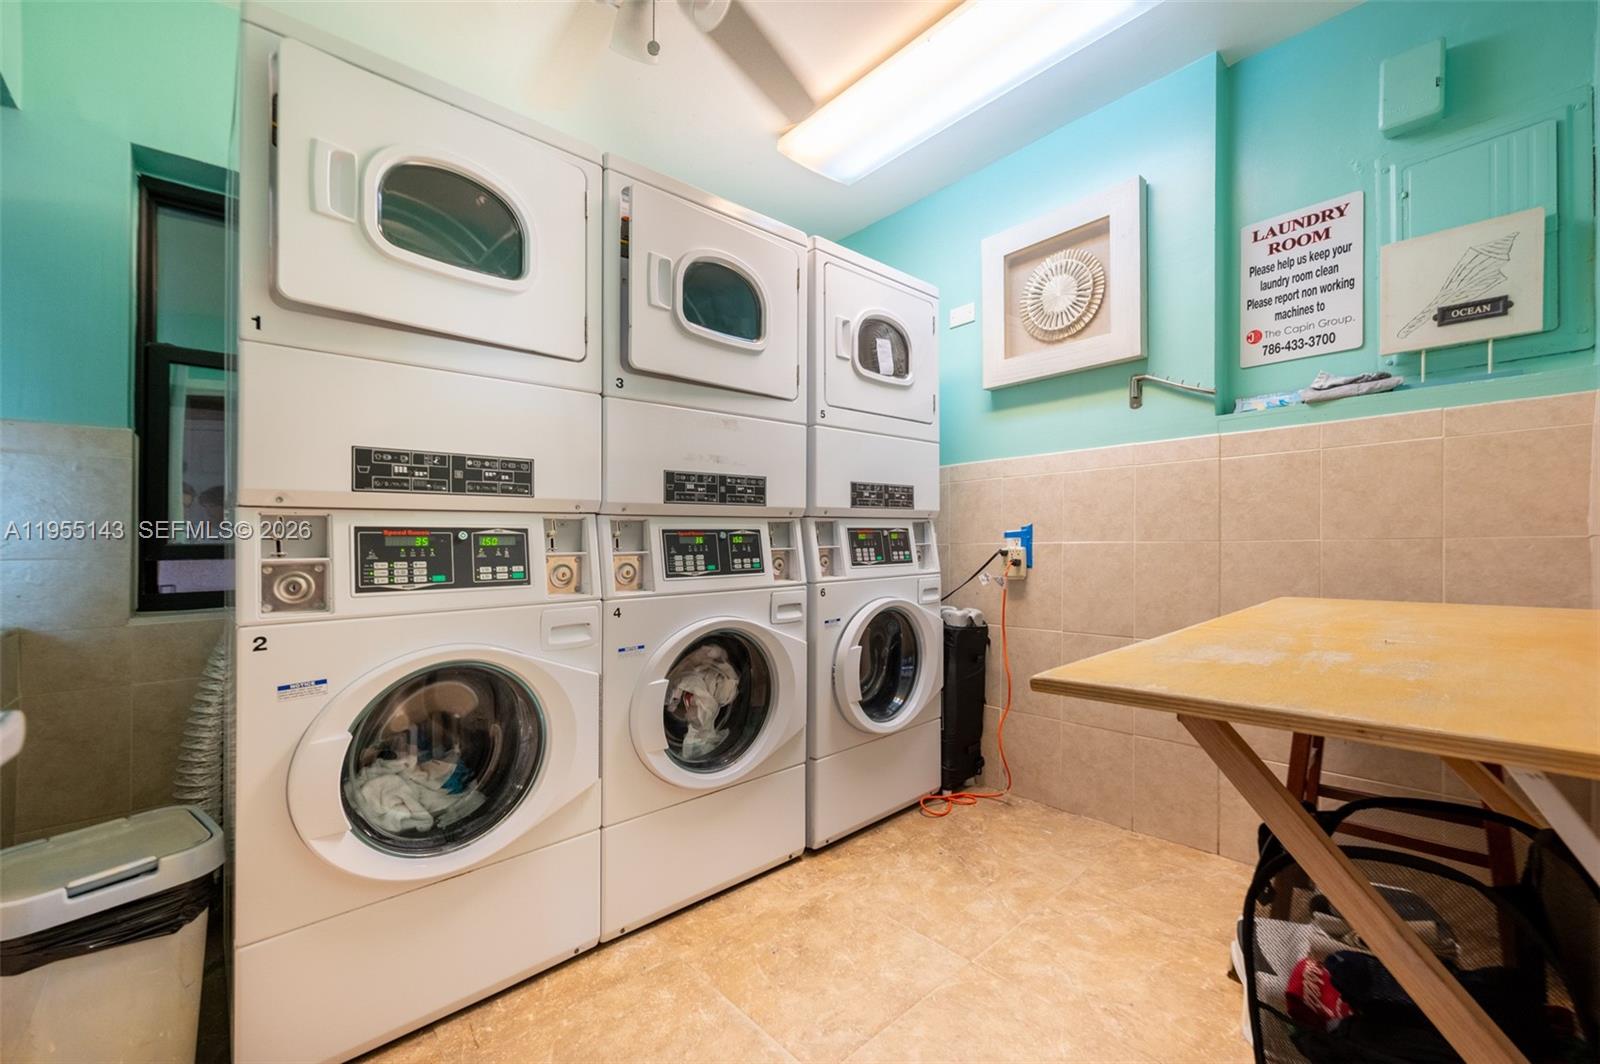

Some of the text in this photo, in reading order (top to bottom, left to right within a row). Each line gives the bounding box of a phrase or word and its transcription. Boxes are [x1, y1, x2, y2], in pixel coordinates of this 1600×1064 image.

[1252, 202, 1350, 243] LAUNDRY
[1267, 227, 1332, 256] ROOM
[1249, 242, 1353, 277] Please help us keep your
[1260, 264, 1339, 291] laundry room clean
[1247, 277, 1355, 310] Please report non working
[1274, 301, 1326, 321] machines to
[1451, 303, 1491, 318] OCEAN
[251, 316, 261, 329] 1
[1265, 330, 1282, 339] The
[1262, 332, 1336, 356] 786-433-3700
[615, 377, 624, 389] 3
[820, 410, 826, 419] 5
[416, 537, 429, 546] 35
[820, 588, 826, 597] 6
[613, 607, 622, 618] 4
[252, 636, 268, 652] 2
